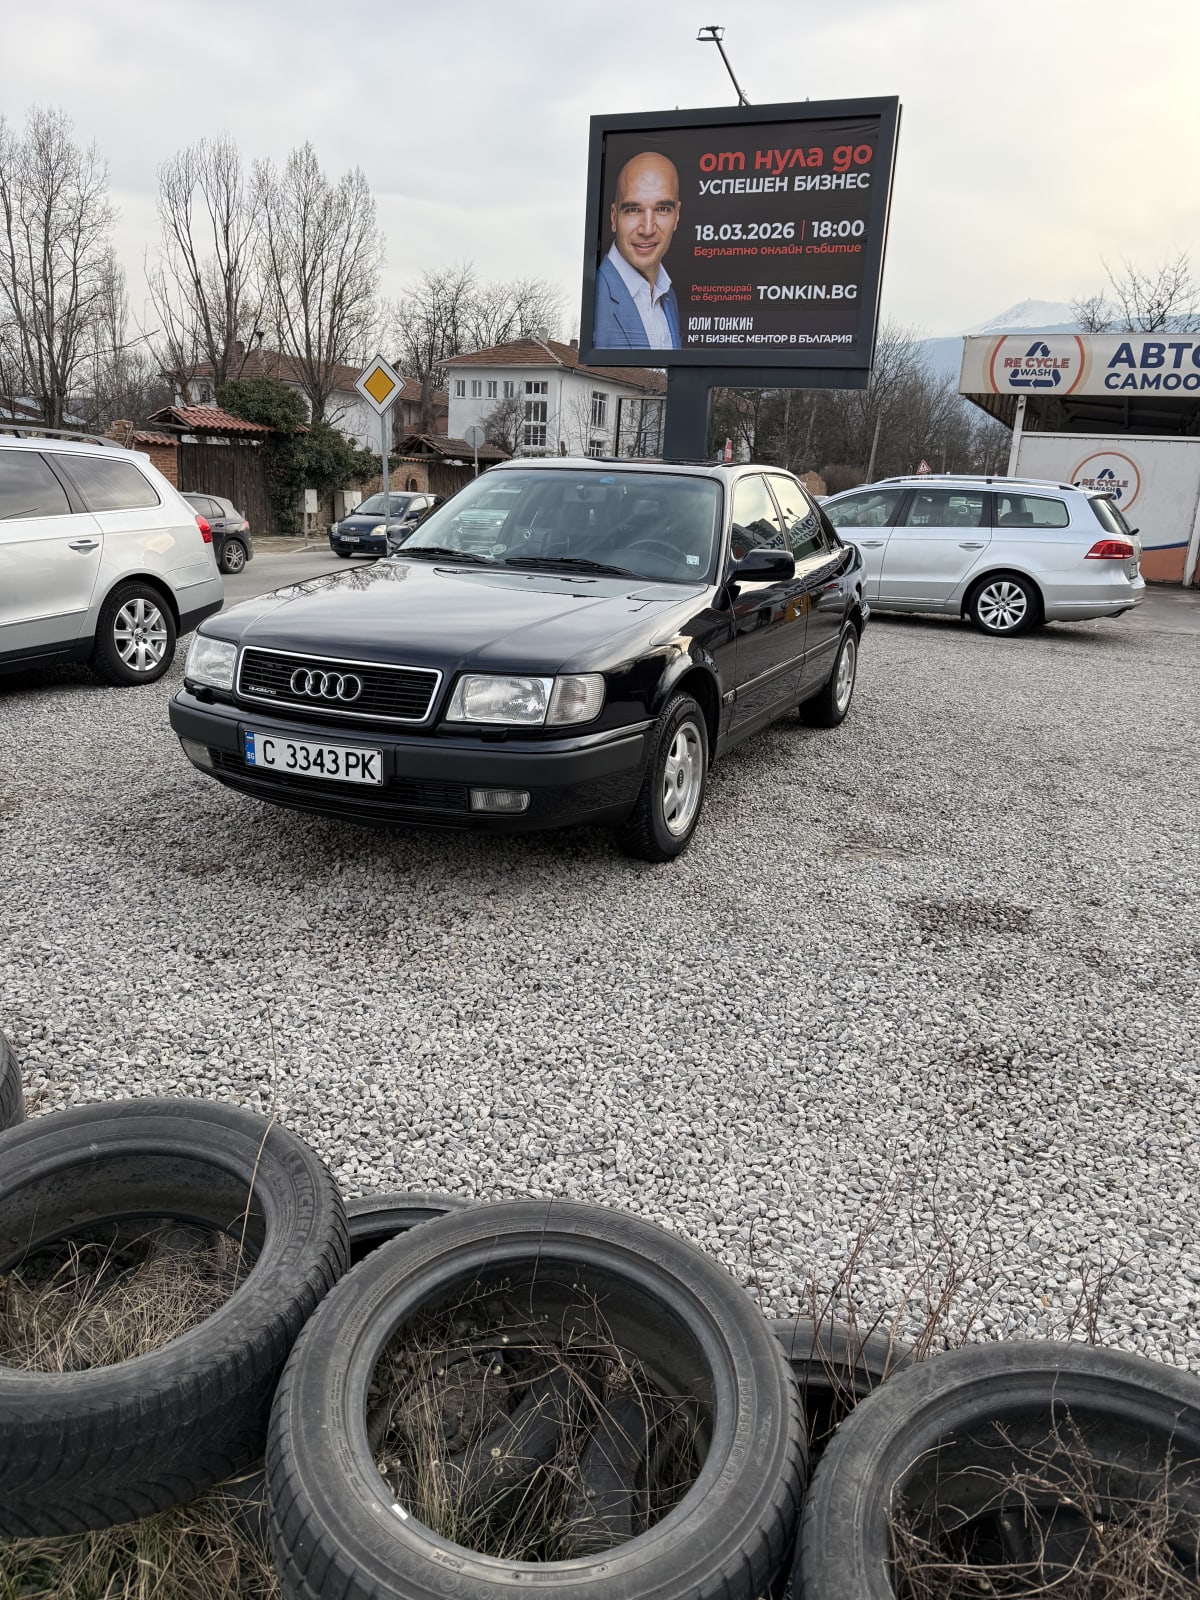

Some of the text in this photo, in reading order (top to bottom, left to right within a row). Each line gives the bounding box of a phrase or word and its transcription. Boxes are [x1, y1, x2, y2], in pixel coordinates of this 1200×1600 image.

[699, 144, 873, 175] от нула до
[699, 172, 870, 195] УСПЕШЕН БИЗНЕС
[694, 219, 865, 241] 18.03.2026 18:00
[693, 242, 862, 258] Безплатно онлайн събитие
[691, 284, 752, 294] Регистрирай
[756, 284, 858, 300] TONKIN.BG
[702, 293, 752, 303] безплатно
[688, 316, 754, 331] ЮЛИ ТОНКИН
[705, 334, 745, 343] БИЗНЕС
[746, 334, 788, 343] МЕНТОР
[789, 334, 797, 343] В
[798, 334, 853, 343] БЪЛГАРИЯ
[1004, 357, 1070, 369] RE CYCLE
[1020, 368, 1052, 377] WASH
[1081, 478, 1129, 488] RE CYCLE
[263, 740, 275, 765] C
[278, 1170, 314, 1266] MICHELIN
[365, 1535, 513, 1600] YOKOHAMA
